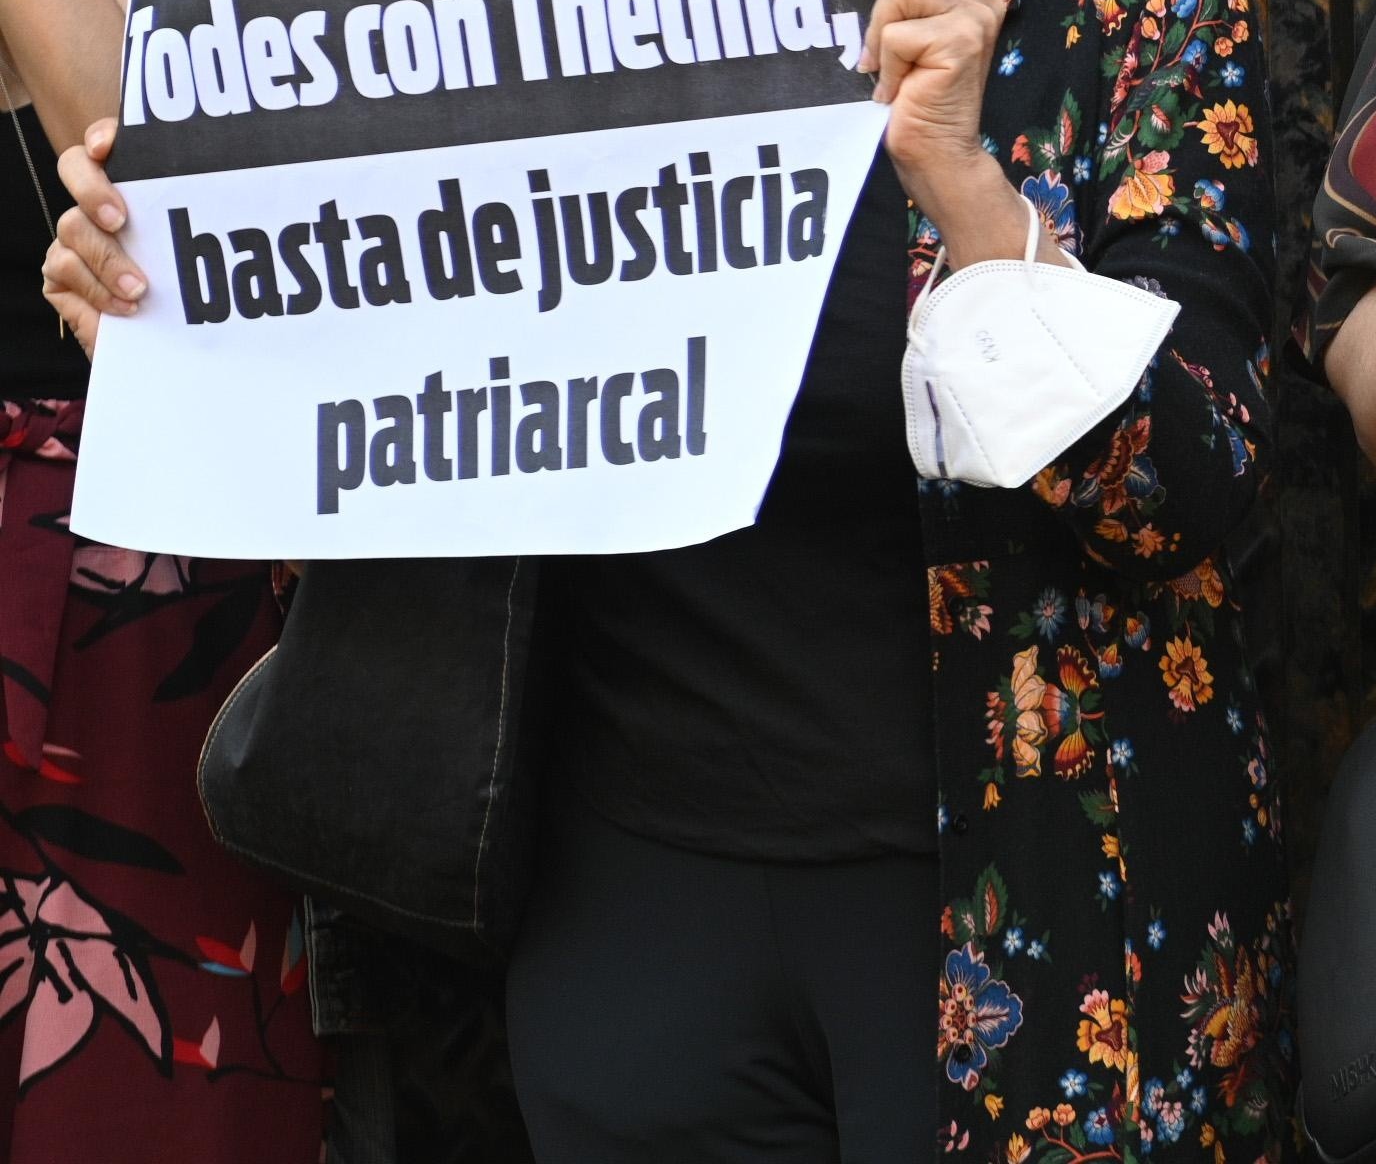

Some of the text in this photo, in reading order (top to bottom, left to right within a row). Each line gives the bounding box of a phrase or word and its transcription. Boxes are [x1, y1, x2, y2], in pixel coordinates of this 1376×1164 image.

[167, 143, 829, 325] basta de justicia
[316, 335, 708, 516] patriarcal
